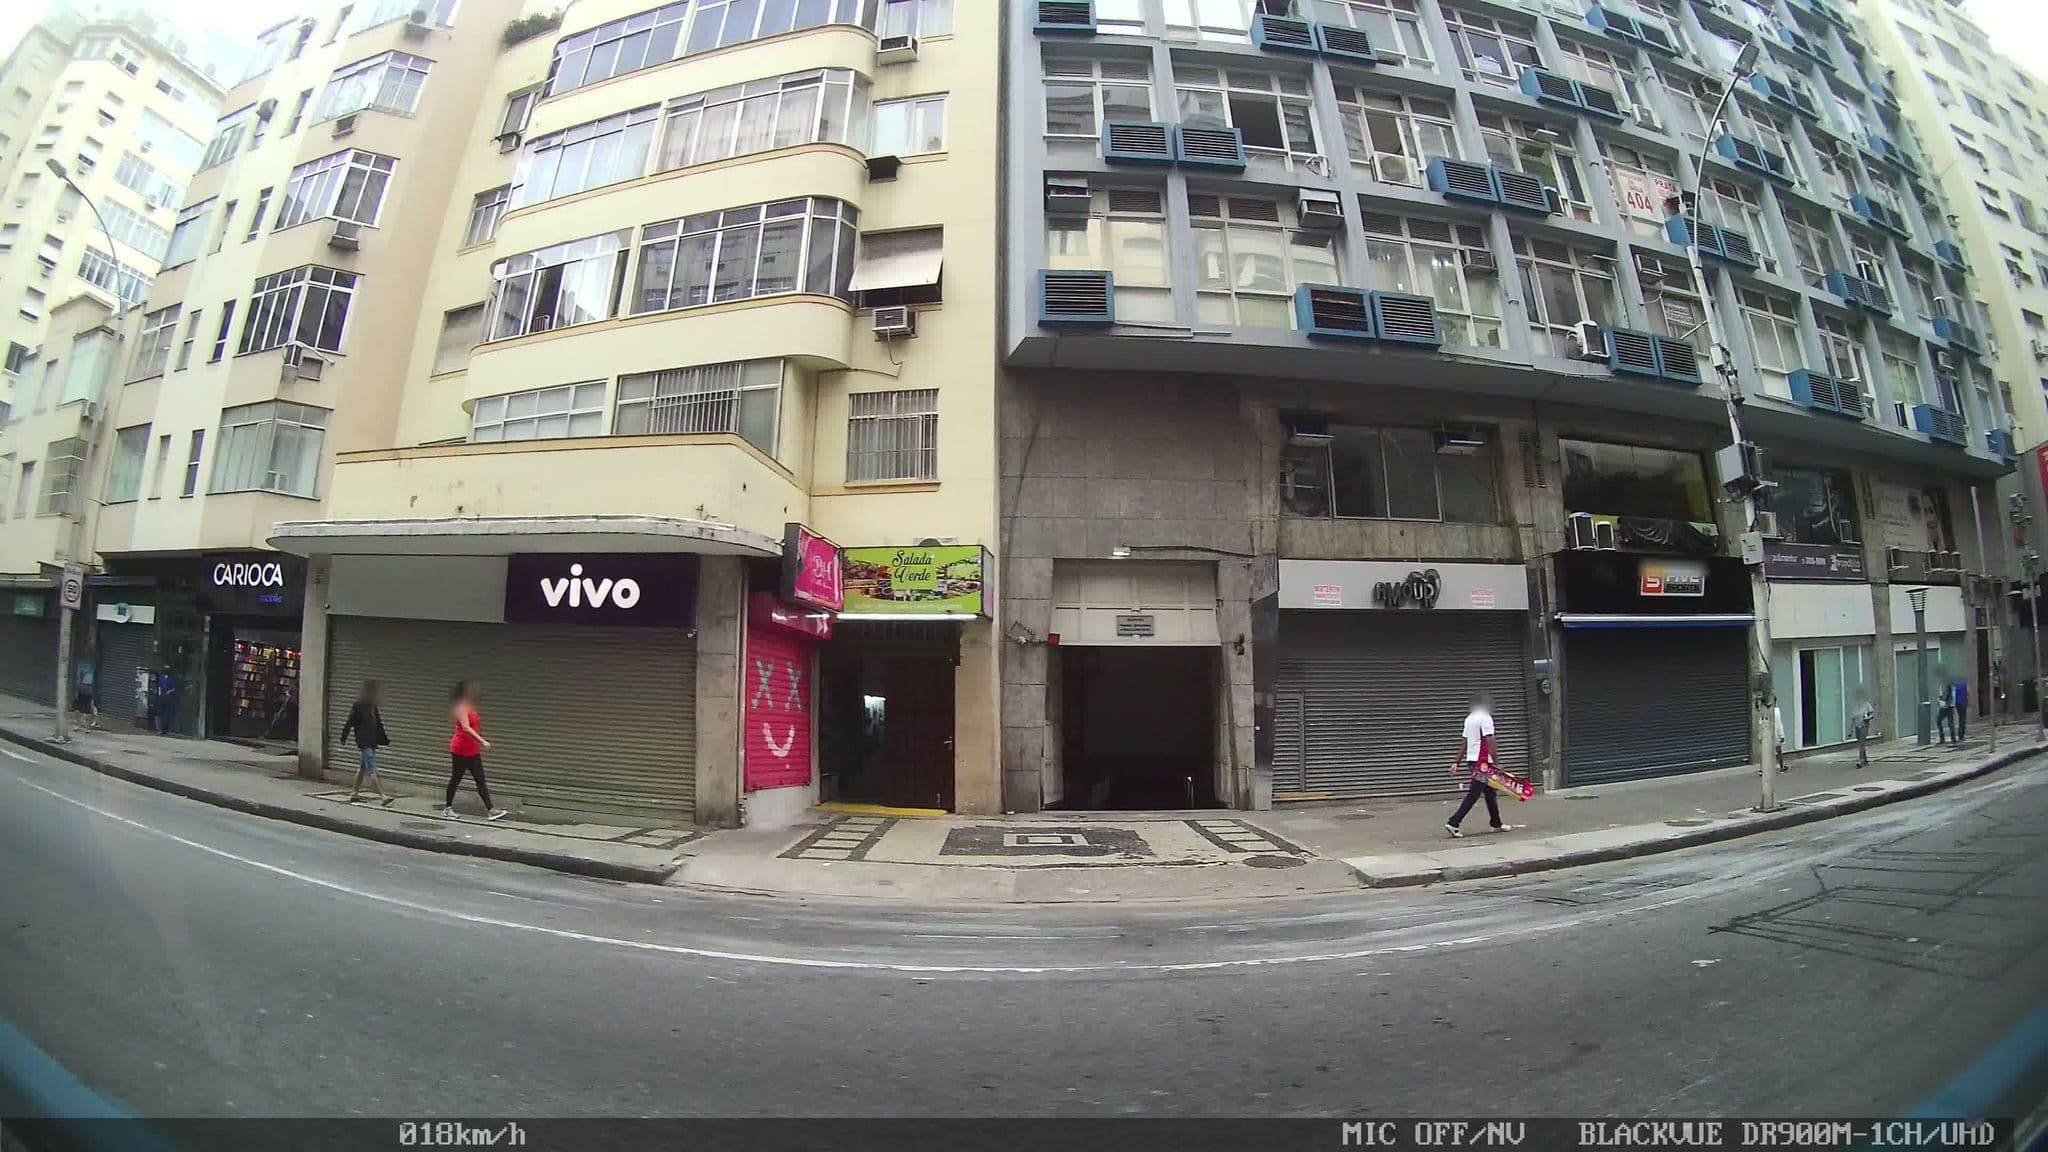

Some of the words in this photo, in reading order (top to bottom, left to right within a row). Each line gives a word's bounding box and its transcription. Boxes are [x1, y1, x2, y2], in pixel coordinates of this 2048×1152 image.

[1627, 191, 1653, 213] 404
[891, 550, 934, 567] Salada
[213, 562, 283, 587] CARIOCA
[893, 566, 931, 583] Verde
[540, 563, 640, 609] vivo
